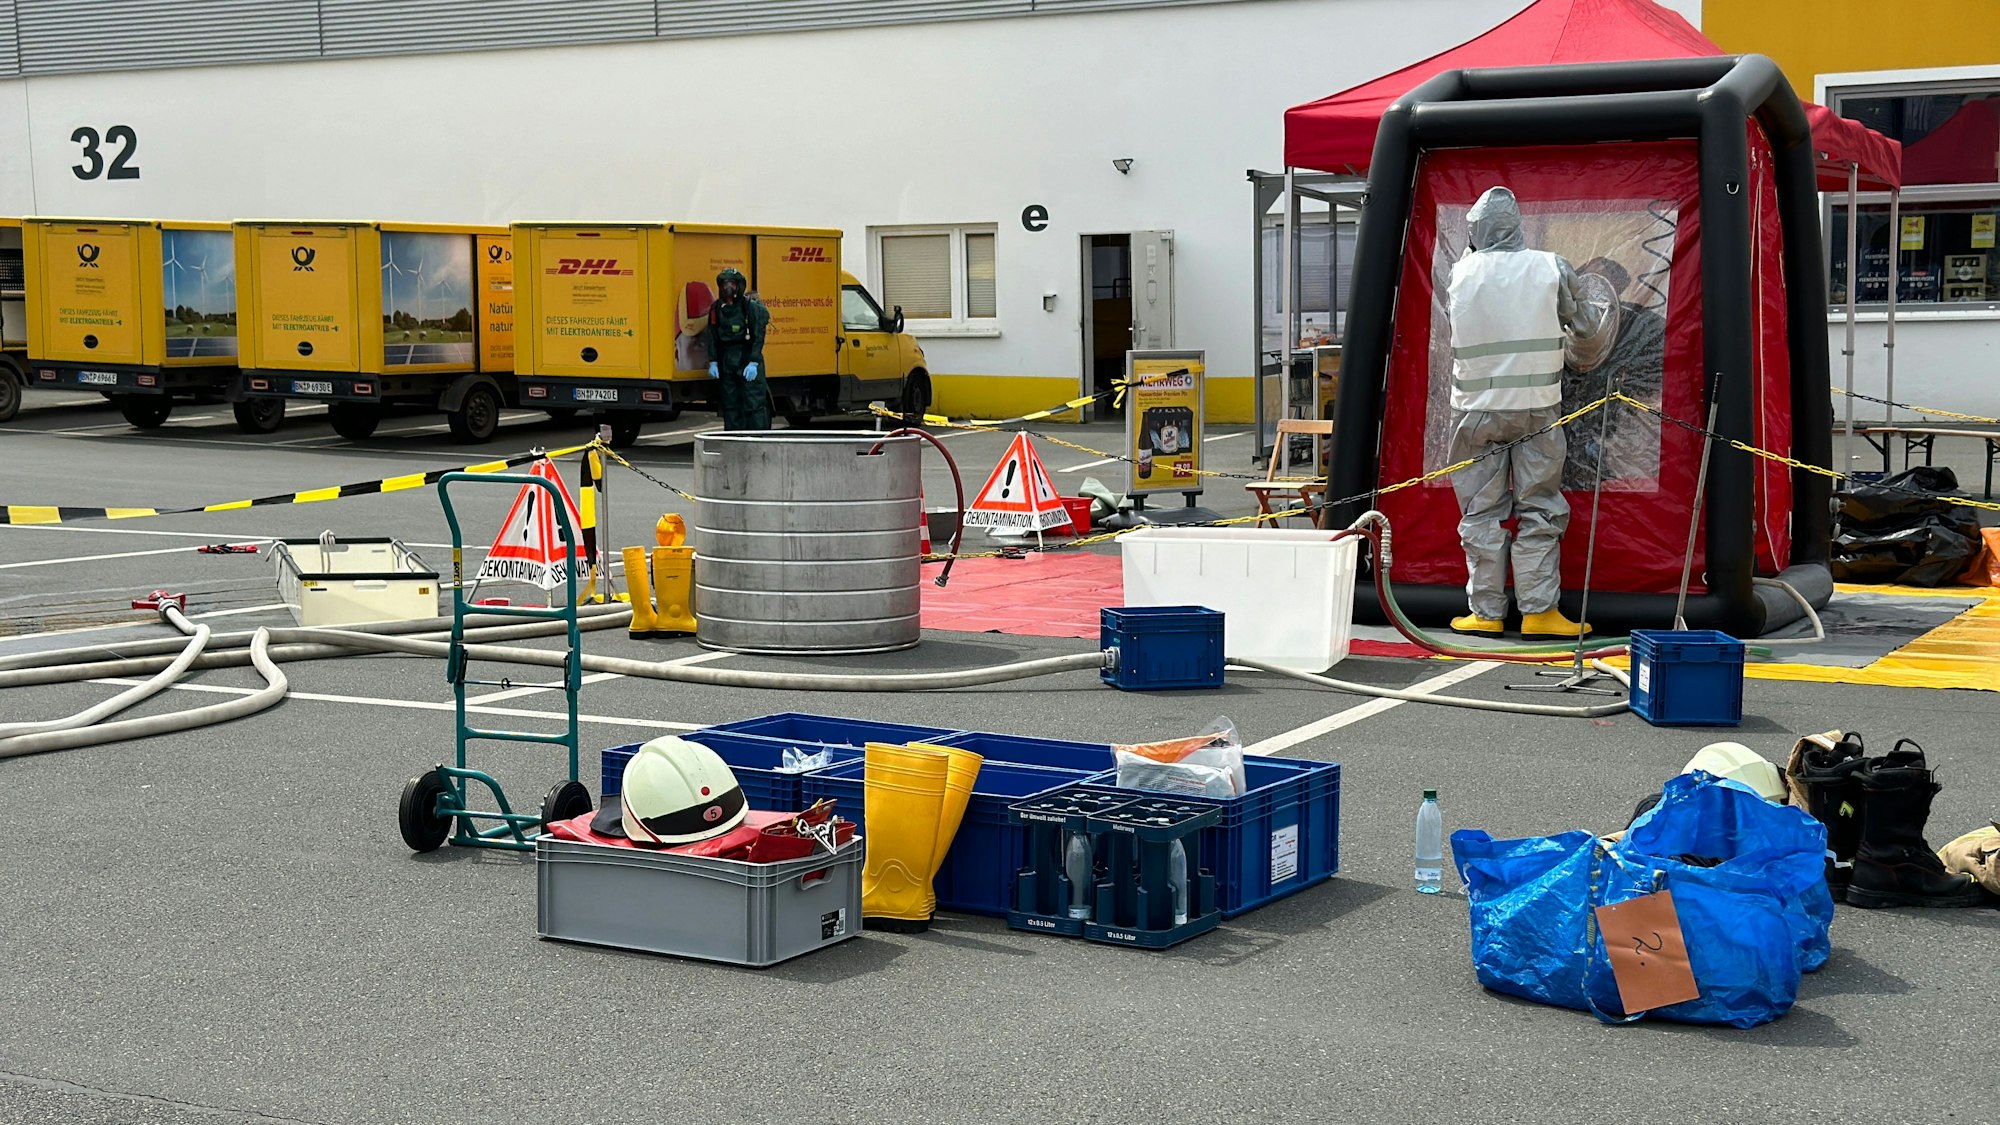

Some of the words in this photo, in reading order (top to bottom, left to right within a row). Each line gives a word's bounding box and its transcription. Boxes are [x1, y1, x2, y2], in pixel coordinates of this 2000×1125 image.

[70, 125, 140, 181] 32
[1021, 204, 1049, 232] e
[789, 247, 825, 262] DHL
[558, 258, 621, 275] DHL
[546, 316, 568, 325] DIESES
[569, 317, 605, 325] FAHRZEUG
[606, 317, 627, 326] FÄHRT
[546, 327, 559, 335] MIT
[965, 511, 1034, 528] DEKONTAMINATION
[710, 808, 717, 818] 5
[1044, 920, 1056, 928] Liter
